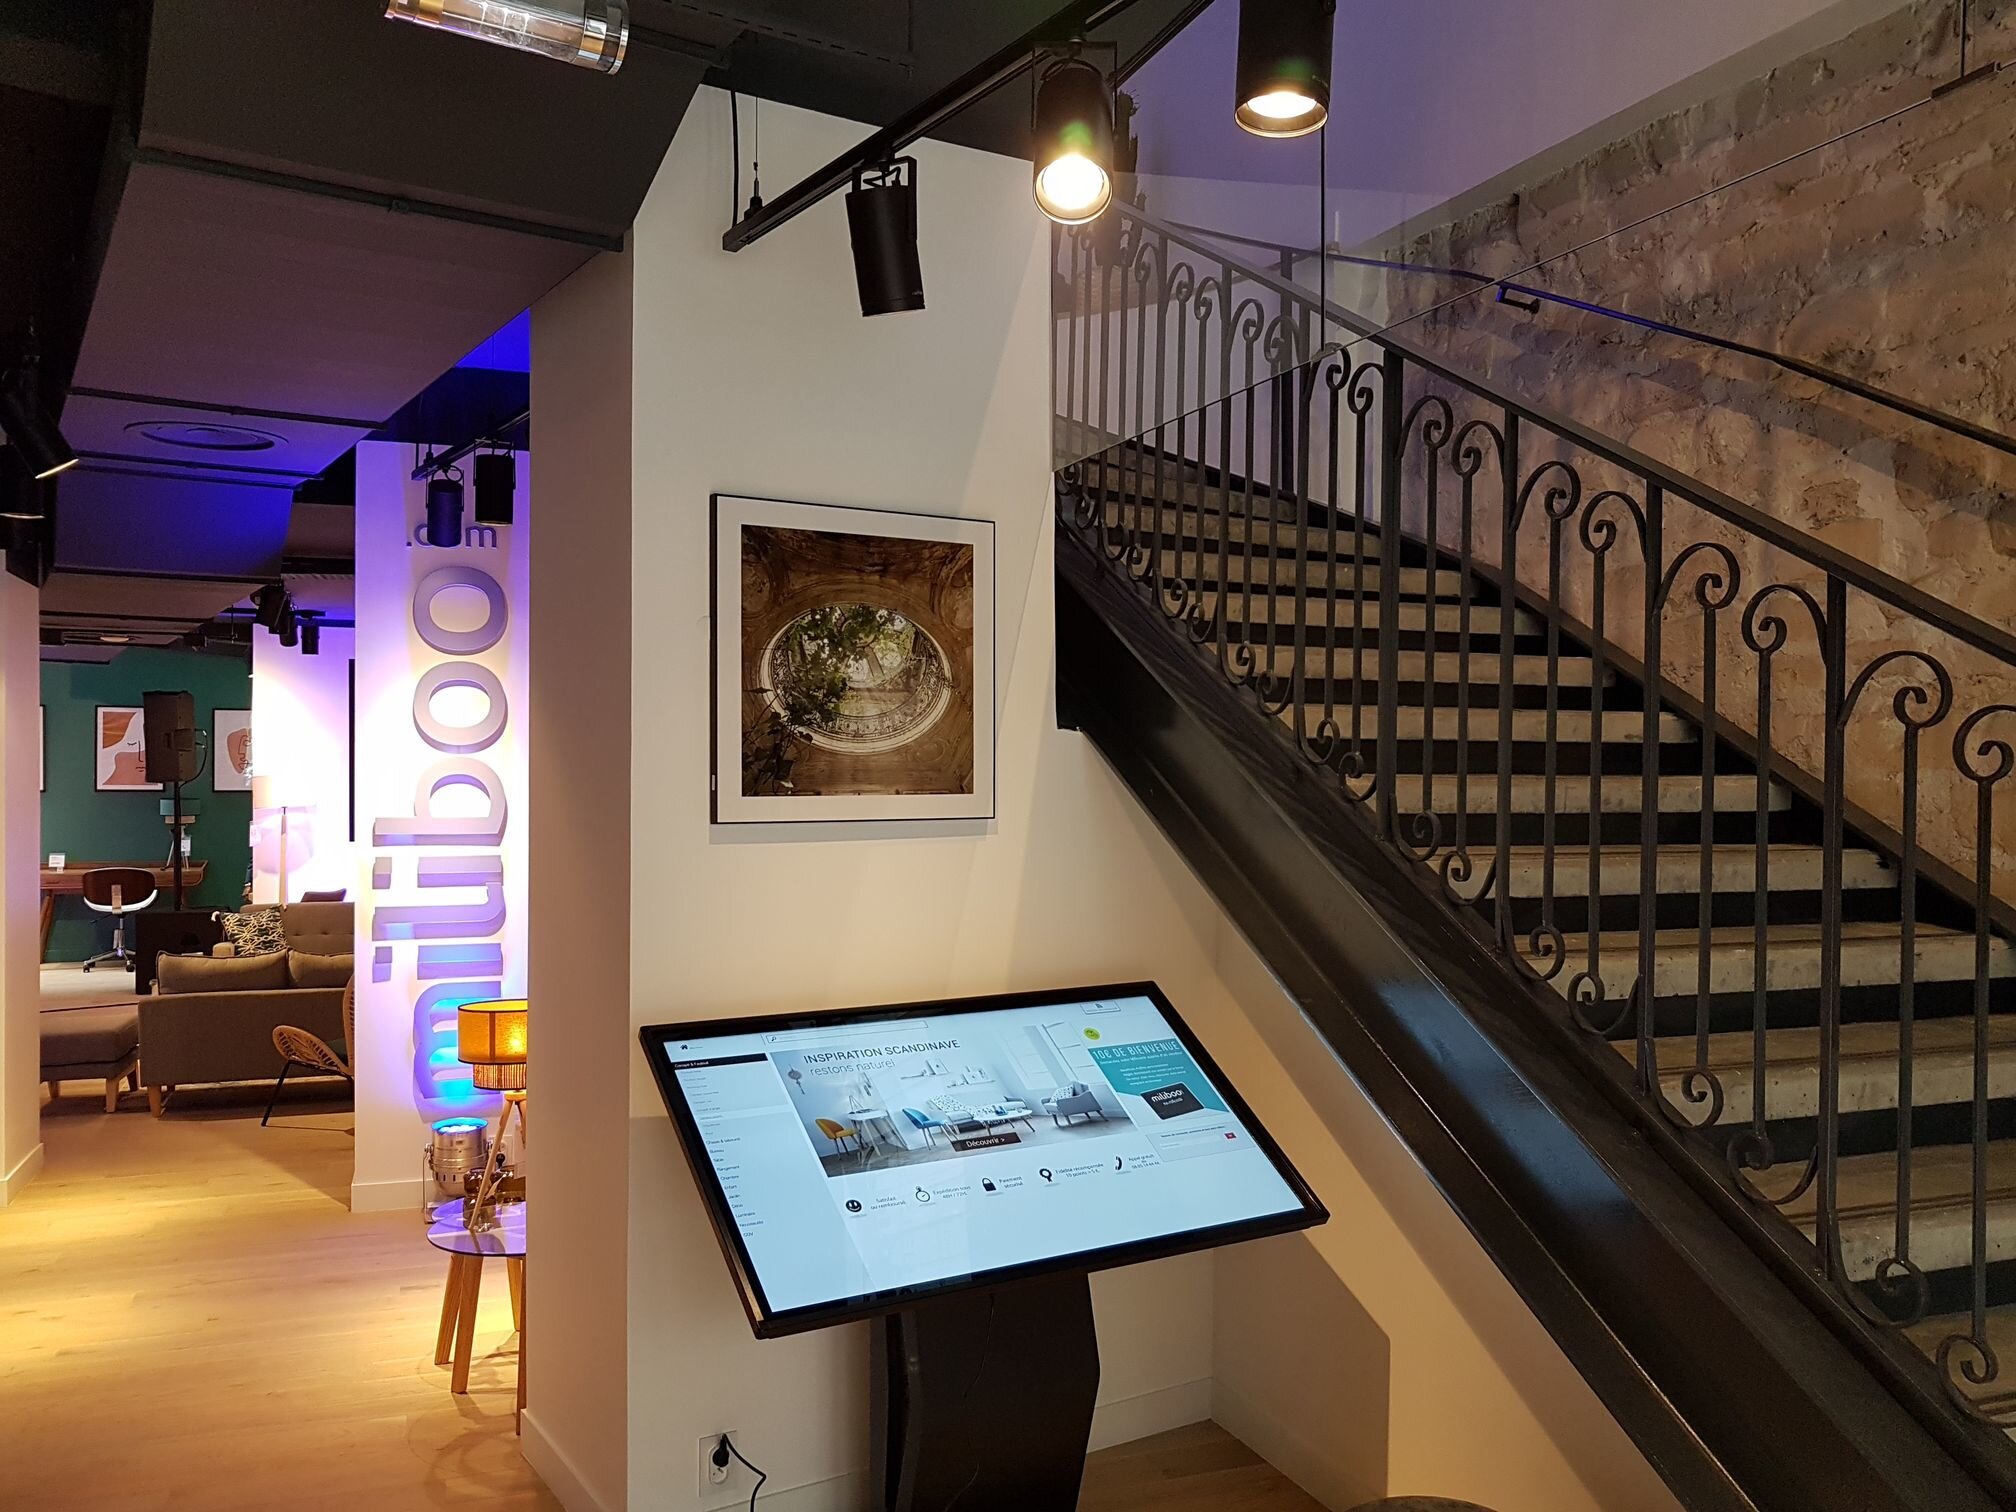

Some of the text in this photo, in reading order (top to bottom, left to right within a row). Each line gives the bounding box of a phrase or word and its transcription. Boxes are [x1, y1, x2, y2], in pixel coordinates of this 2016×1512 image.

[407, 524, 497, 547] .cm
[372, 565, 508, 1101] miliboo
[804, 1040, 960, 1064] INSPIRATION SCANDINAVE
[1093, 1050, 1112, 1059] 10€
[1113, 1048, 1127, 1057] DE
[1128, 1041, 1180, 1055] BIENVENUE
[810, 1059, 895, 1076] restons naturel
[1151, 1089, 1182, 1103] miliboo
[966, 1136, 1000, 1149] Découvrir
